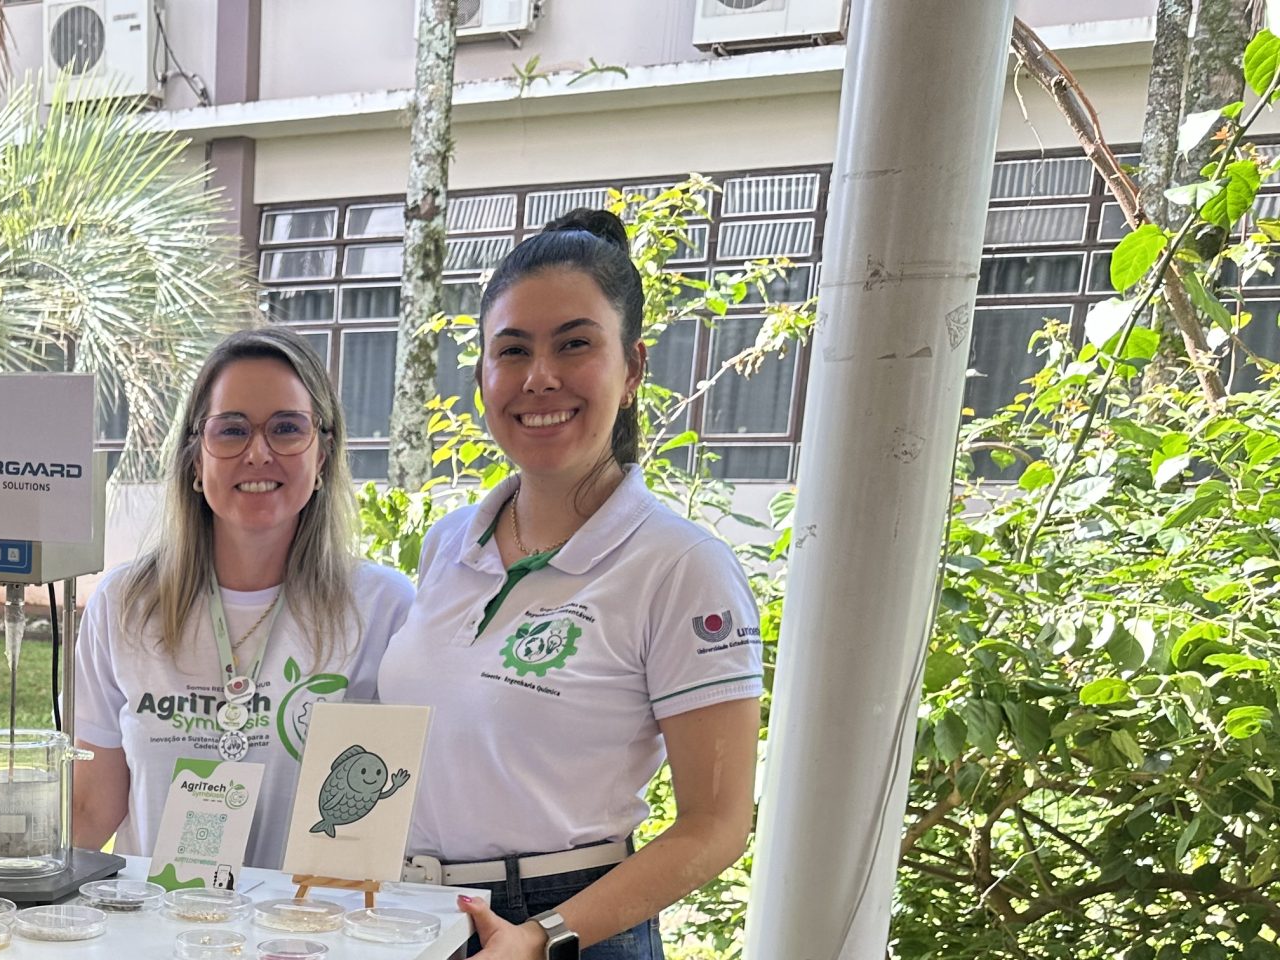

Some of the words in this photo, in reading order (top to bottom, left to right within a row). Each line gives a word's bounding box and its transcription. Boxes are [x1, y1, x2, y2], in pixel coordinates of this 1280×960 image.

[3, 481, 51, 492] SOLUTIONS
[172, 713, 270, 733] Symsis
[181, 780, 226, 792] AgriTech
